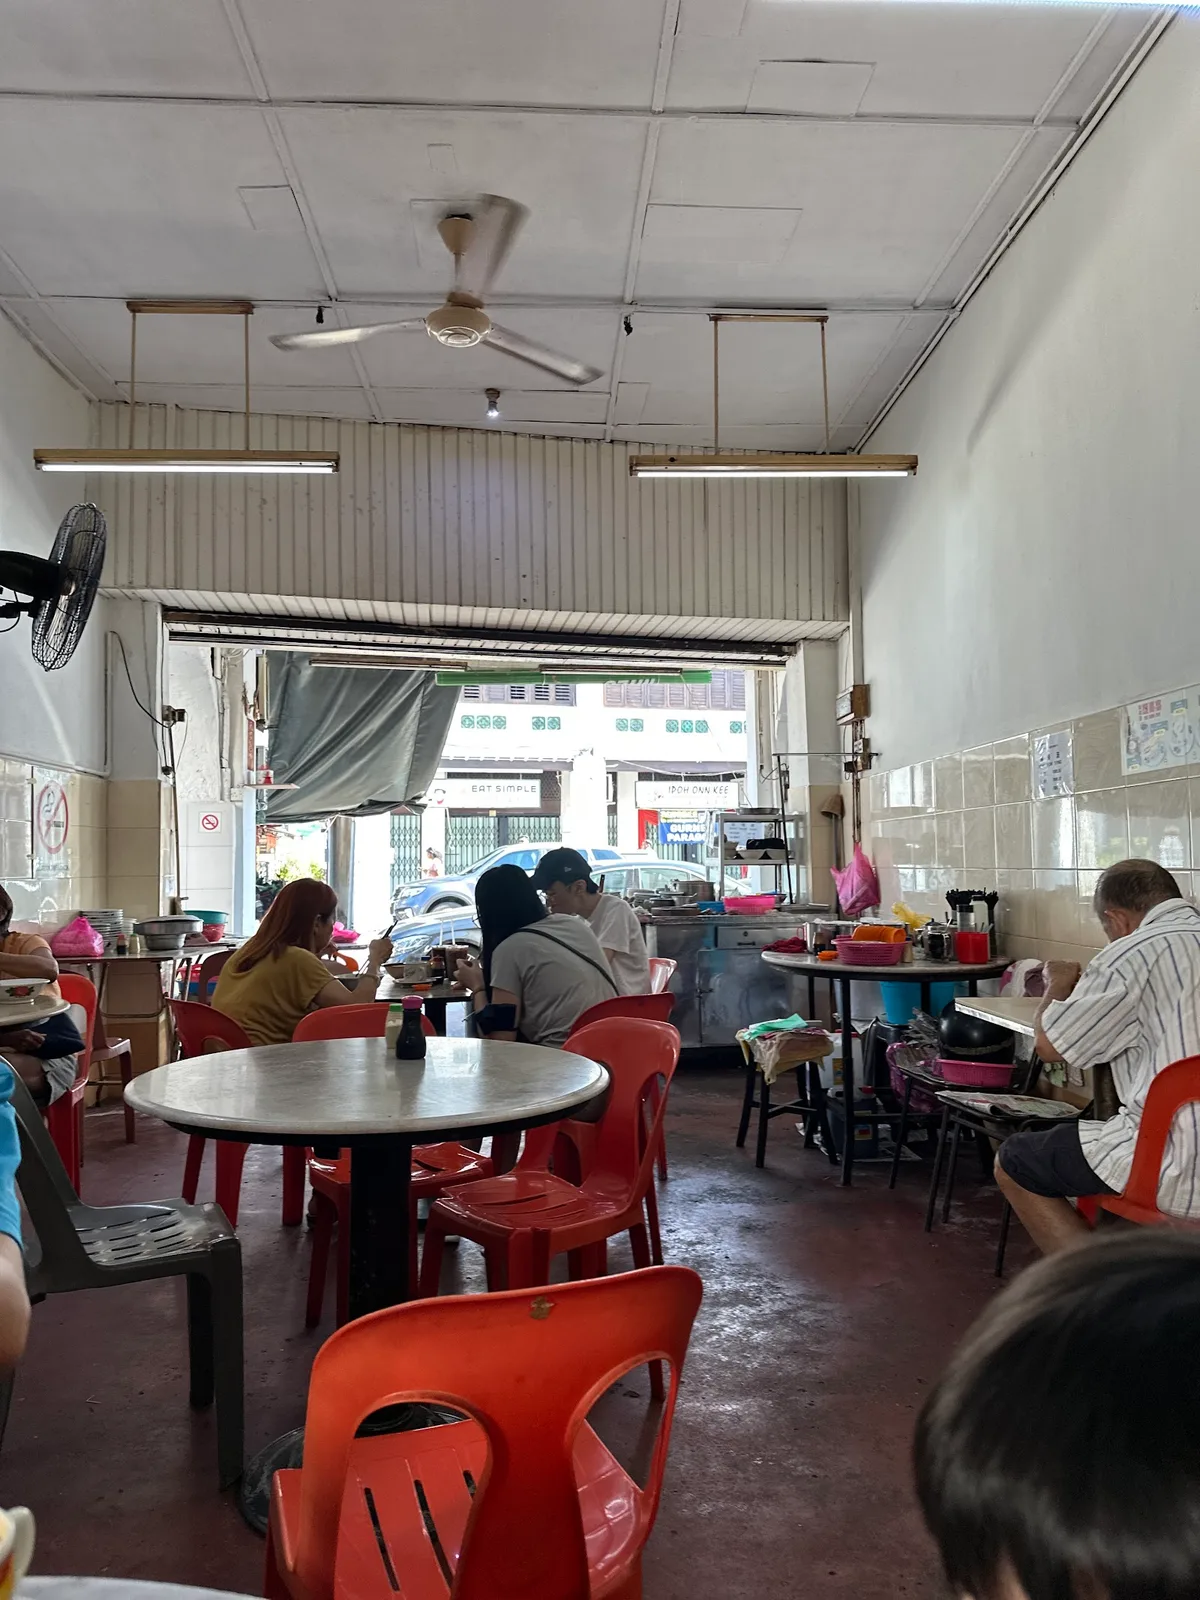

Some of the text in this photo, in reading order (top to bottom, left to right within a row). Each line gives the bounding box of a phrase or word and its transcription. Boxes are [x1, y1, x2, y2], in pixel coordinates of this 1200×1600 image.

[471, 785, 537, 793] EAT SIMPLE
[668, 785, 729, 794] IPOH ONN KEE
